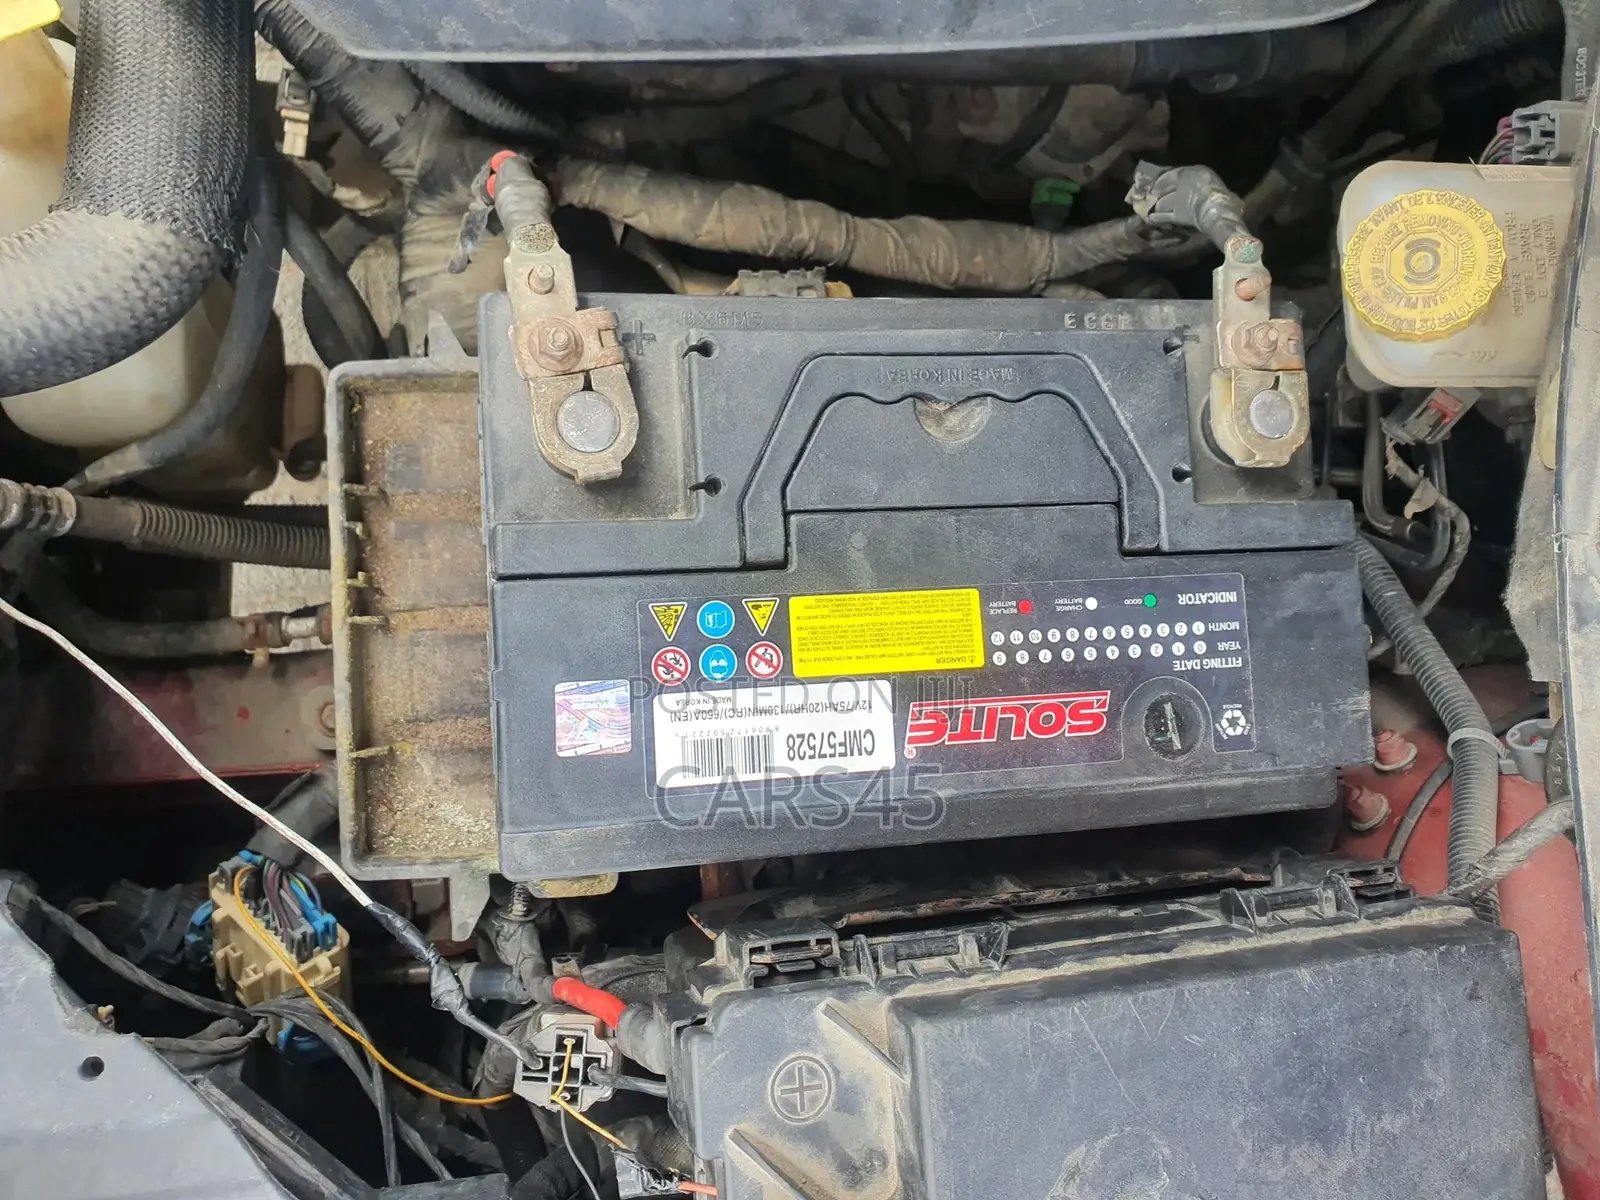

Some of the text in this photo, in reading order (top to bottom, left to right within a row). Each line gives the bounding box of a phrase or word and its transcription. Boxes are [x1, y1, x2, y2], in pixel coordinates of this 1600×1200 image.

[1458, 231, 1477, 284] WARNING
[1054, 597, 1083, 605] BATTERY
[1178, 591, 1237, 605] INDICATOR
[989, 600, 1017, 608] BATTERY
[1055, 604, 1083, 612] CHARGE
[989, 606, 1018, 615] REPLACE
[1208, 621, 1240, 631] MONTH
[1217, 641, 1241, 651] YEAR
[936, 656, 967, 664] DANGER
[1173, 656, 1242, 672] FITTING DATE
[675, 696, 732, 706] MADE IN KOREA
[906, 690, 1111, 748] SOLITE
[786, 728, 876, 761] CMF57528
